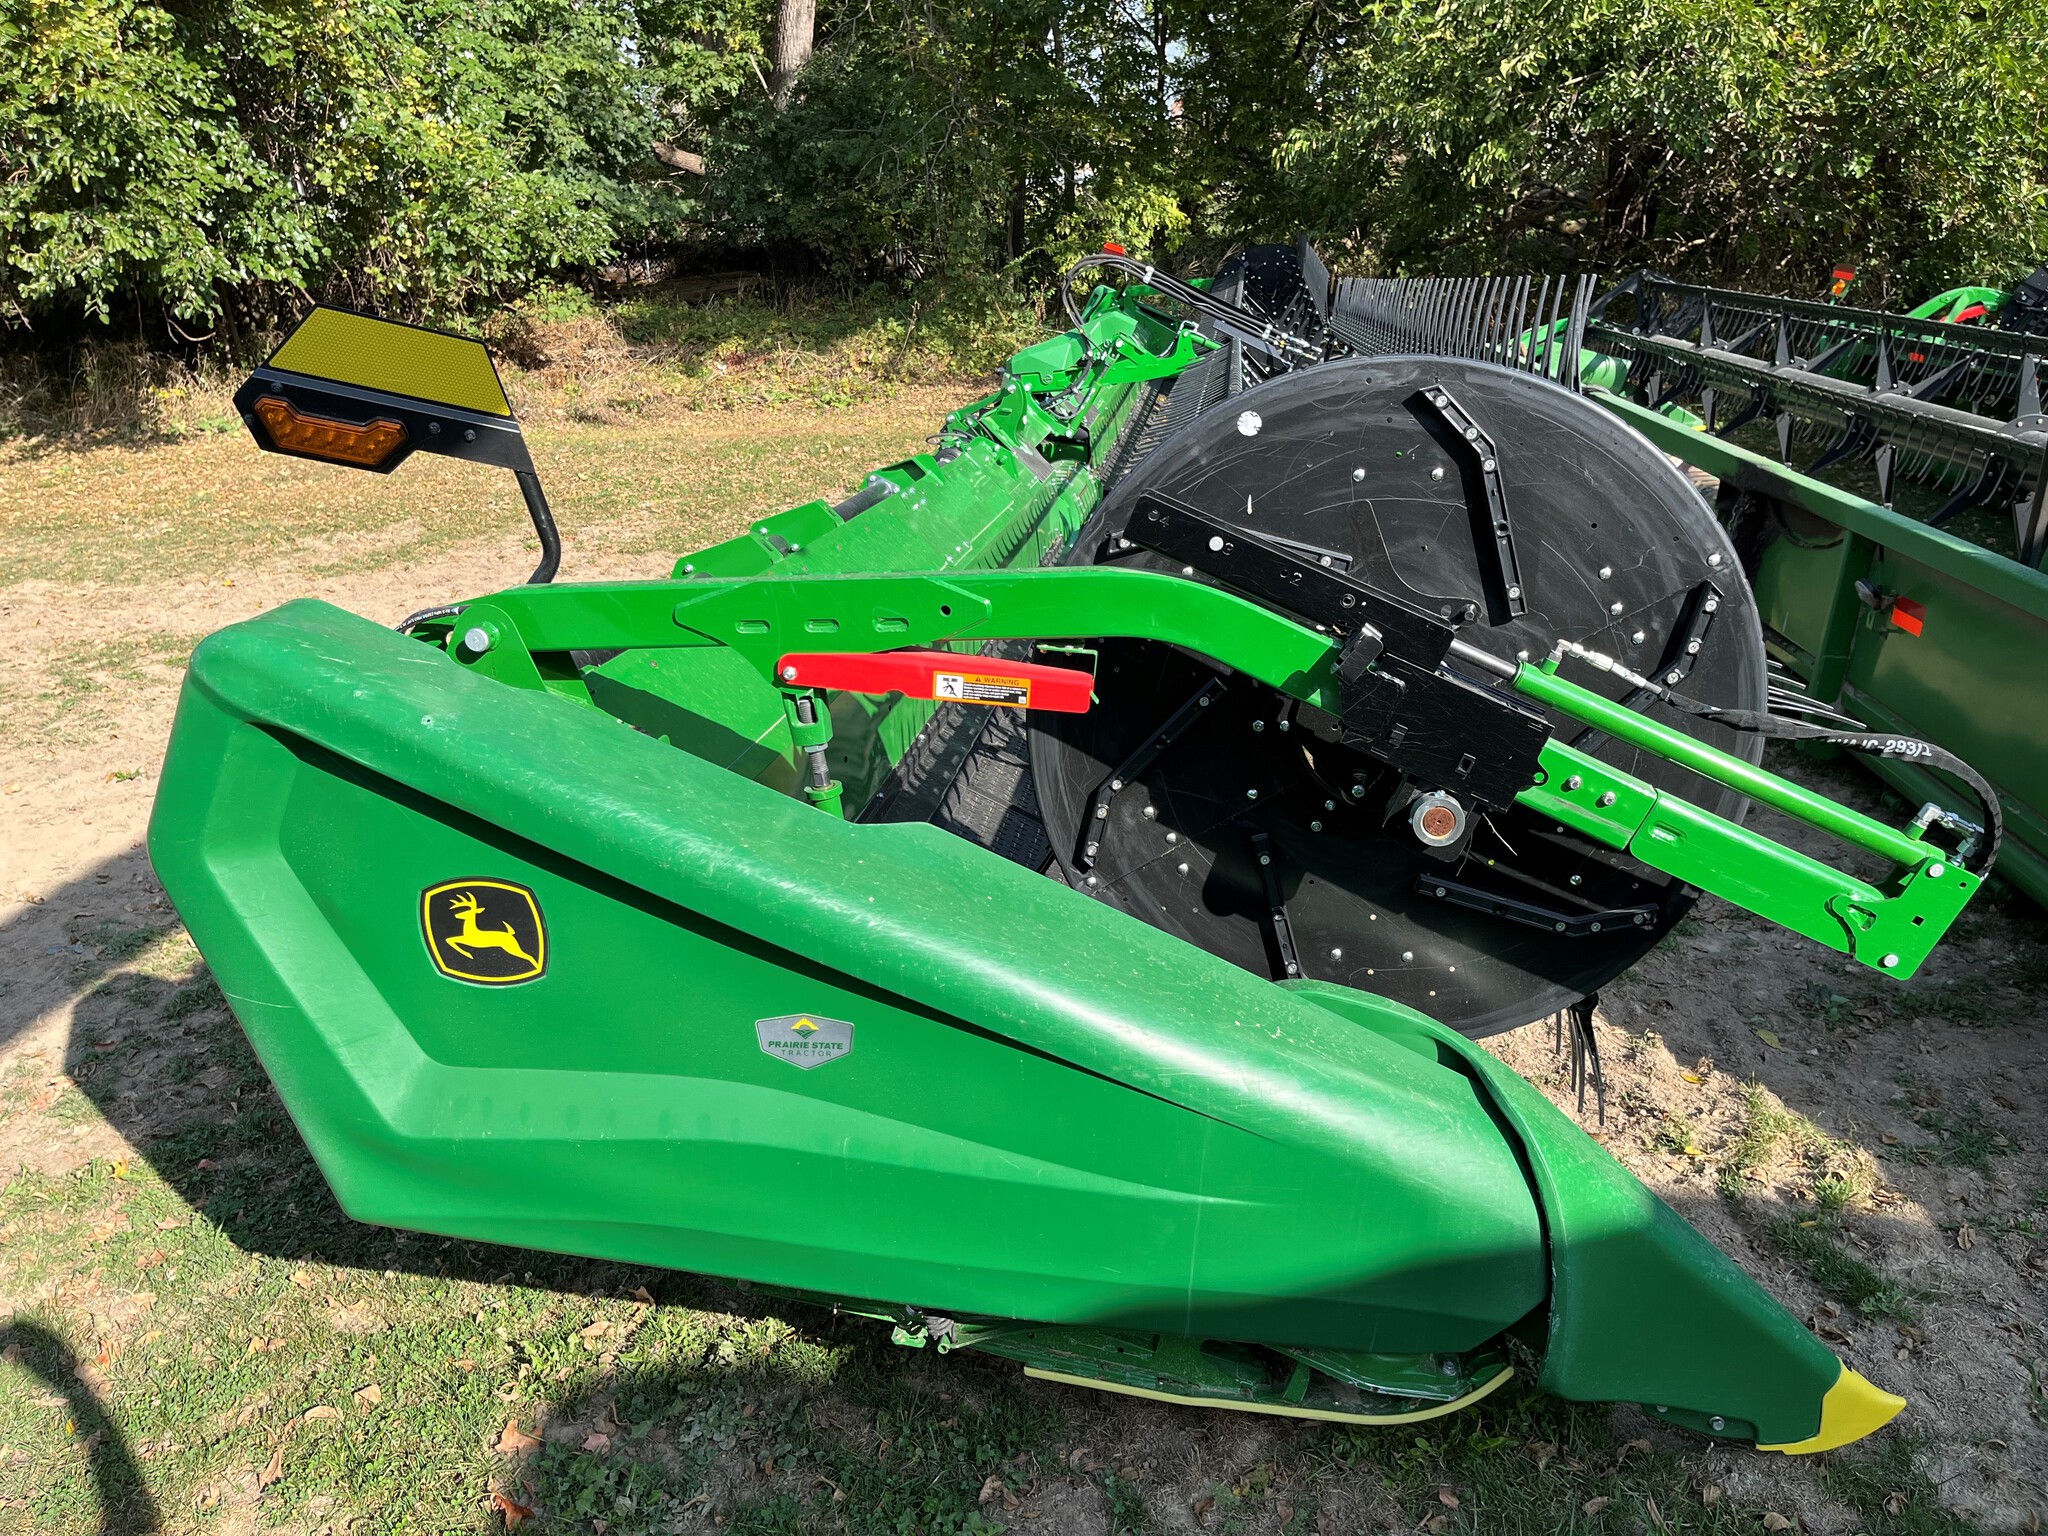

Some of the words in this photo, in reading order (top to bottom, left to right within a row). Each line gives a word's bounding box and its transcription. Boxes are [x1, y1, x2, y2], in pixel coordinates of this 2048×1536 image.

[1289, 571, 1303, 587] 2
[984, 677, 1020, 686] WARNING
[768, 1040, 810, 1049] PRAIRIE
[811, 1041, 844, 1050] STATE
[781, 1049, 832, 1057] TRACTOR
